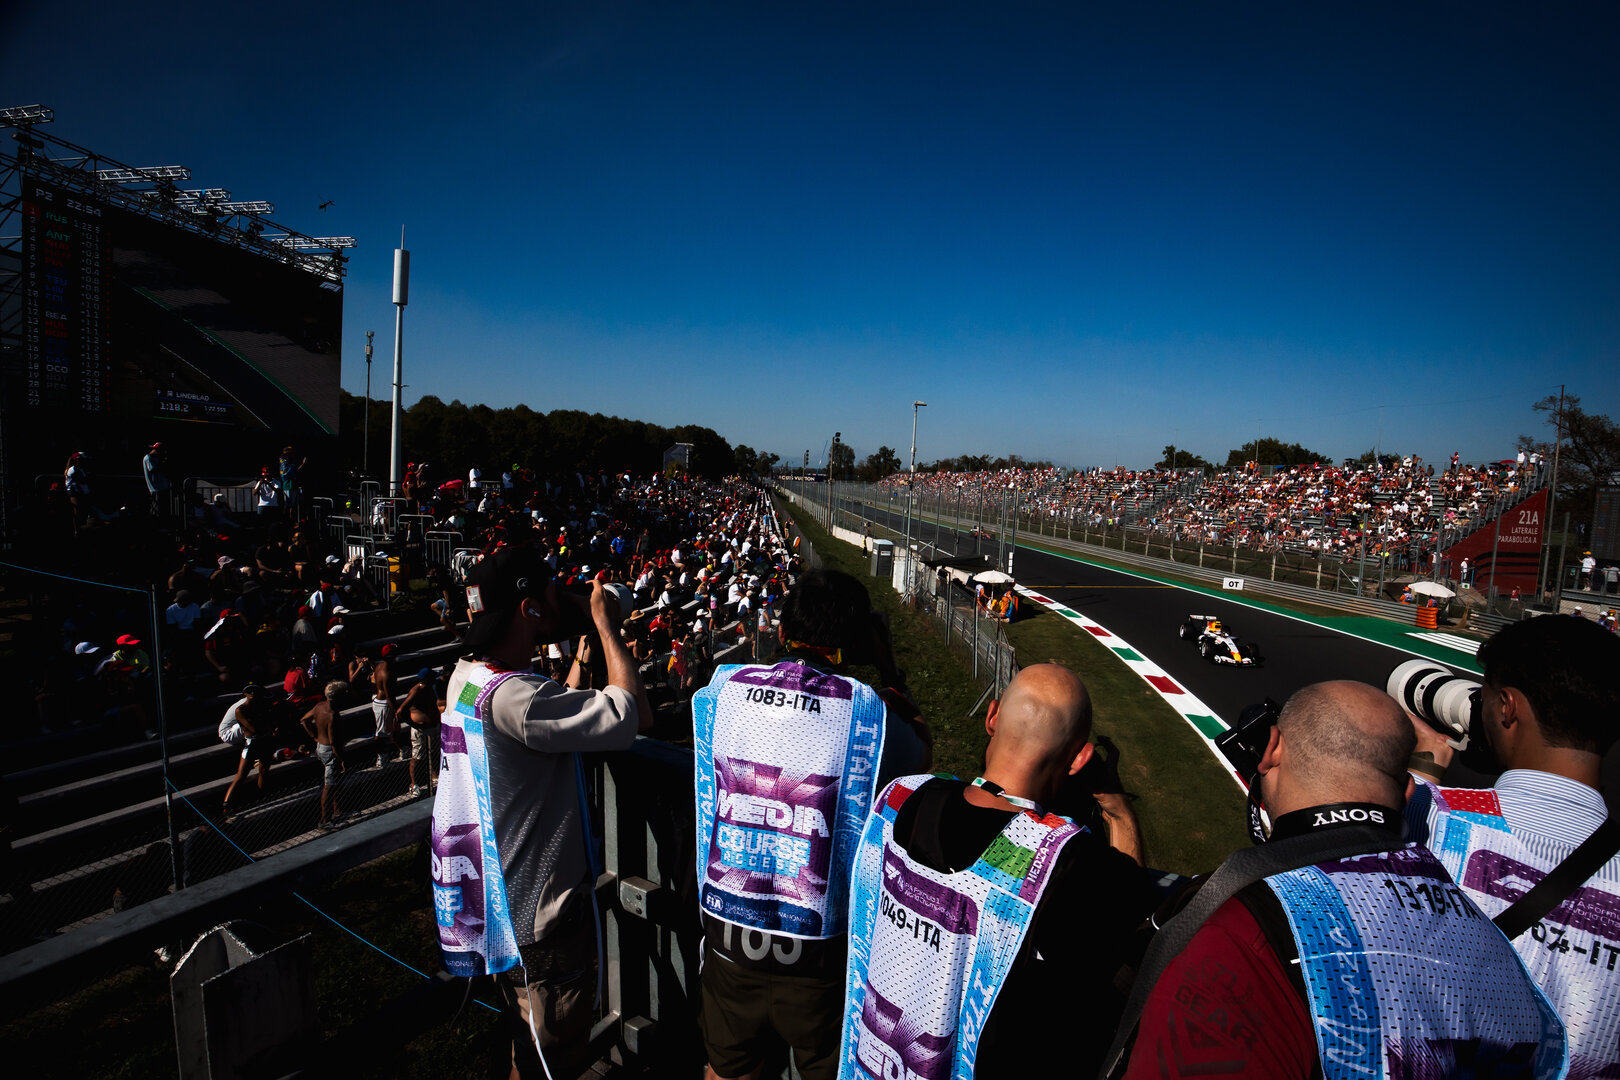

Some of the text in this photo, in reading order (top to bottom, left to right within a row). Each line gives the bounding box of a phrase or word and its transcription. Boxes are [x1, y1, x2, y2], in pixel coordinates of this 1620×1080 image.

[36, 188, 55, 202] P2
[45, 230, 71, 242] ANT
[45, 364, 69, 374] OCO
[160, 402, 190, 413] 1:18.2
[175, 392, 210, 402] LINDBLAD
[1511, 527, 1539, 535] LATERALE
[1518, 510, 1539, 525] 21A
[1498, 535, 1532, 544] PARABOLICA
[1228, 580, 1240, 588] OT
[745, 686, 821, 714] 1083-ITA
[696, 695, 715, 847] ITALY Monza
[843, 719, 878, 808] ITALY
[473, 774, 501, 853] ITALY
[717, 788, 831, 839] MEDIA
[1250, 803, 1267, 843] SONY
[1313, 808, 1386, 828] SONY
[717, 826, 809, 869] COURSE
[1026, 823, 1076, 884] MEDIA-COURSE
[431, 847, 481, 884] DIA
[722, 854, 799, 875] ACCESS
[705, 894, 725, 912] FIA
[880, 890, 941, 953] 1049-ITA
[1531, 921, 1620, 972] 074-IT
[1317, 911, 1382, 1077] Monza
[847, 969, 868, 1064] ITALY
